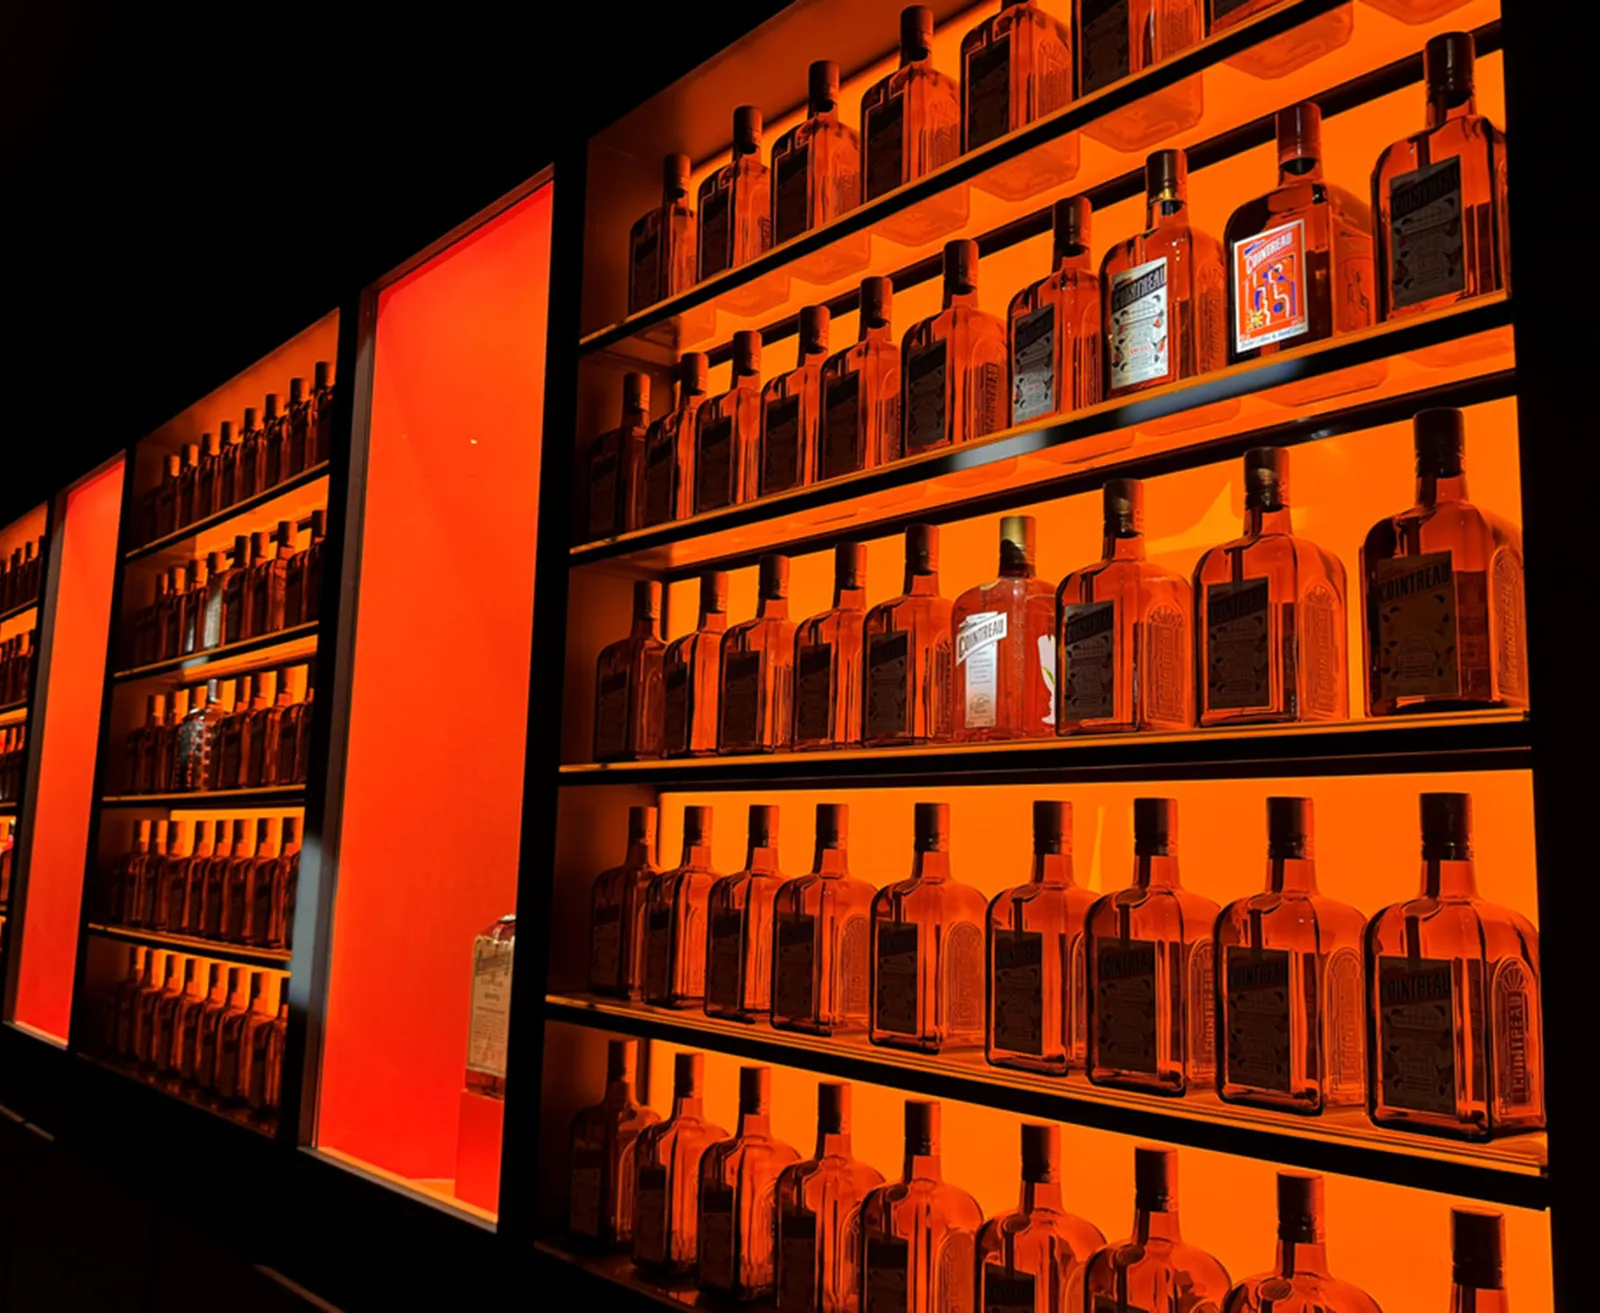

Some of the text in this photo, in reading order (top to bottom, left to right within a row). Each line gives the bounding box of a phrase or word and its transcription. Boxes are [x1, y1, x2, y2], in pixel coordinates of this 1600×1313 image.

[1246, 231, 1292, 274] COINTREAU
[1379, 561, 1450, 602] COINTREAU
[959, 617, 1005, 659] COINTREAU
